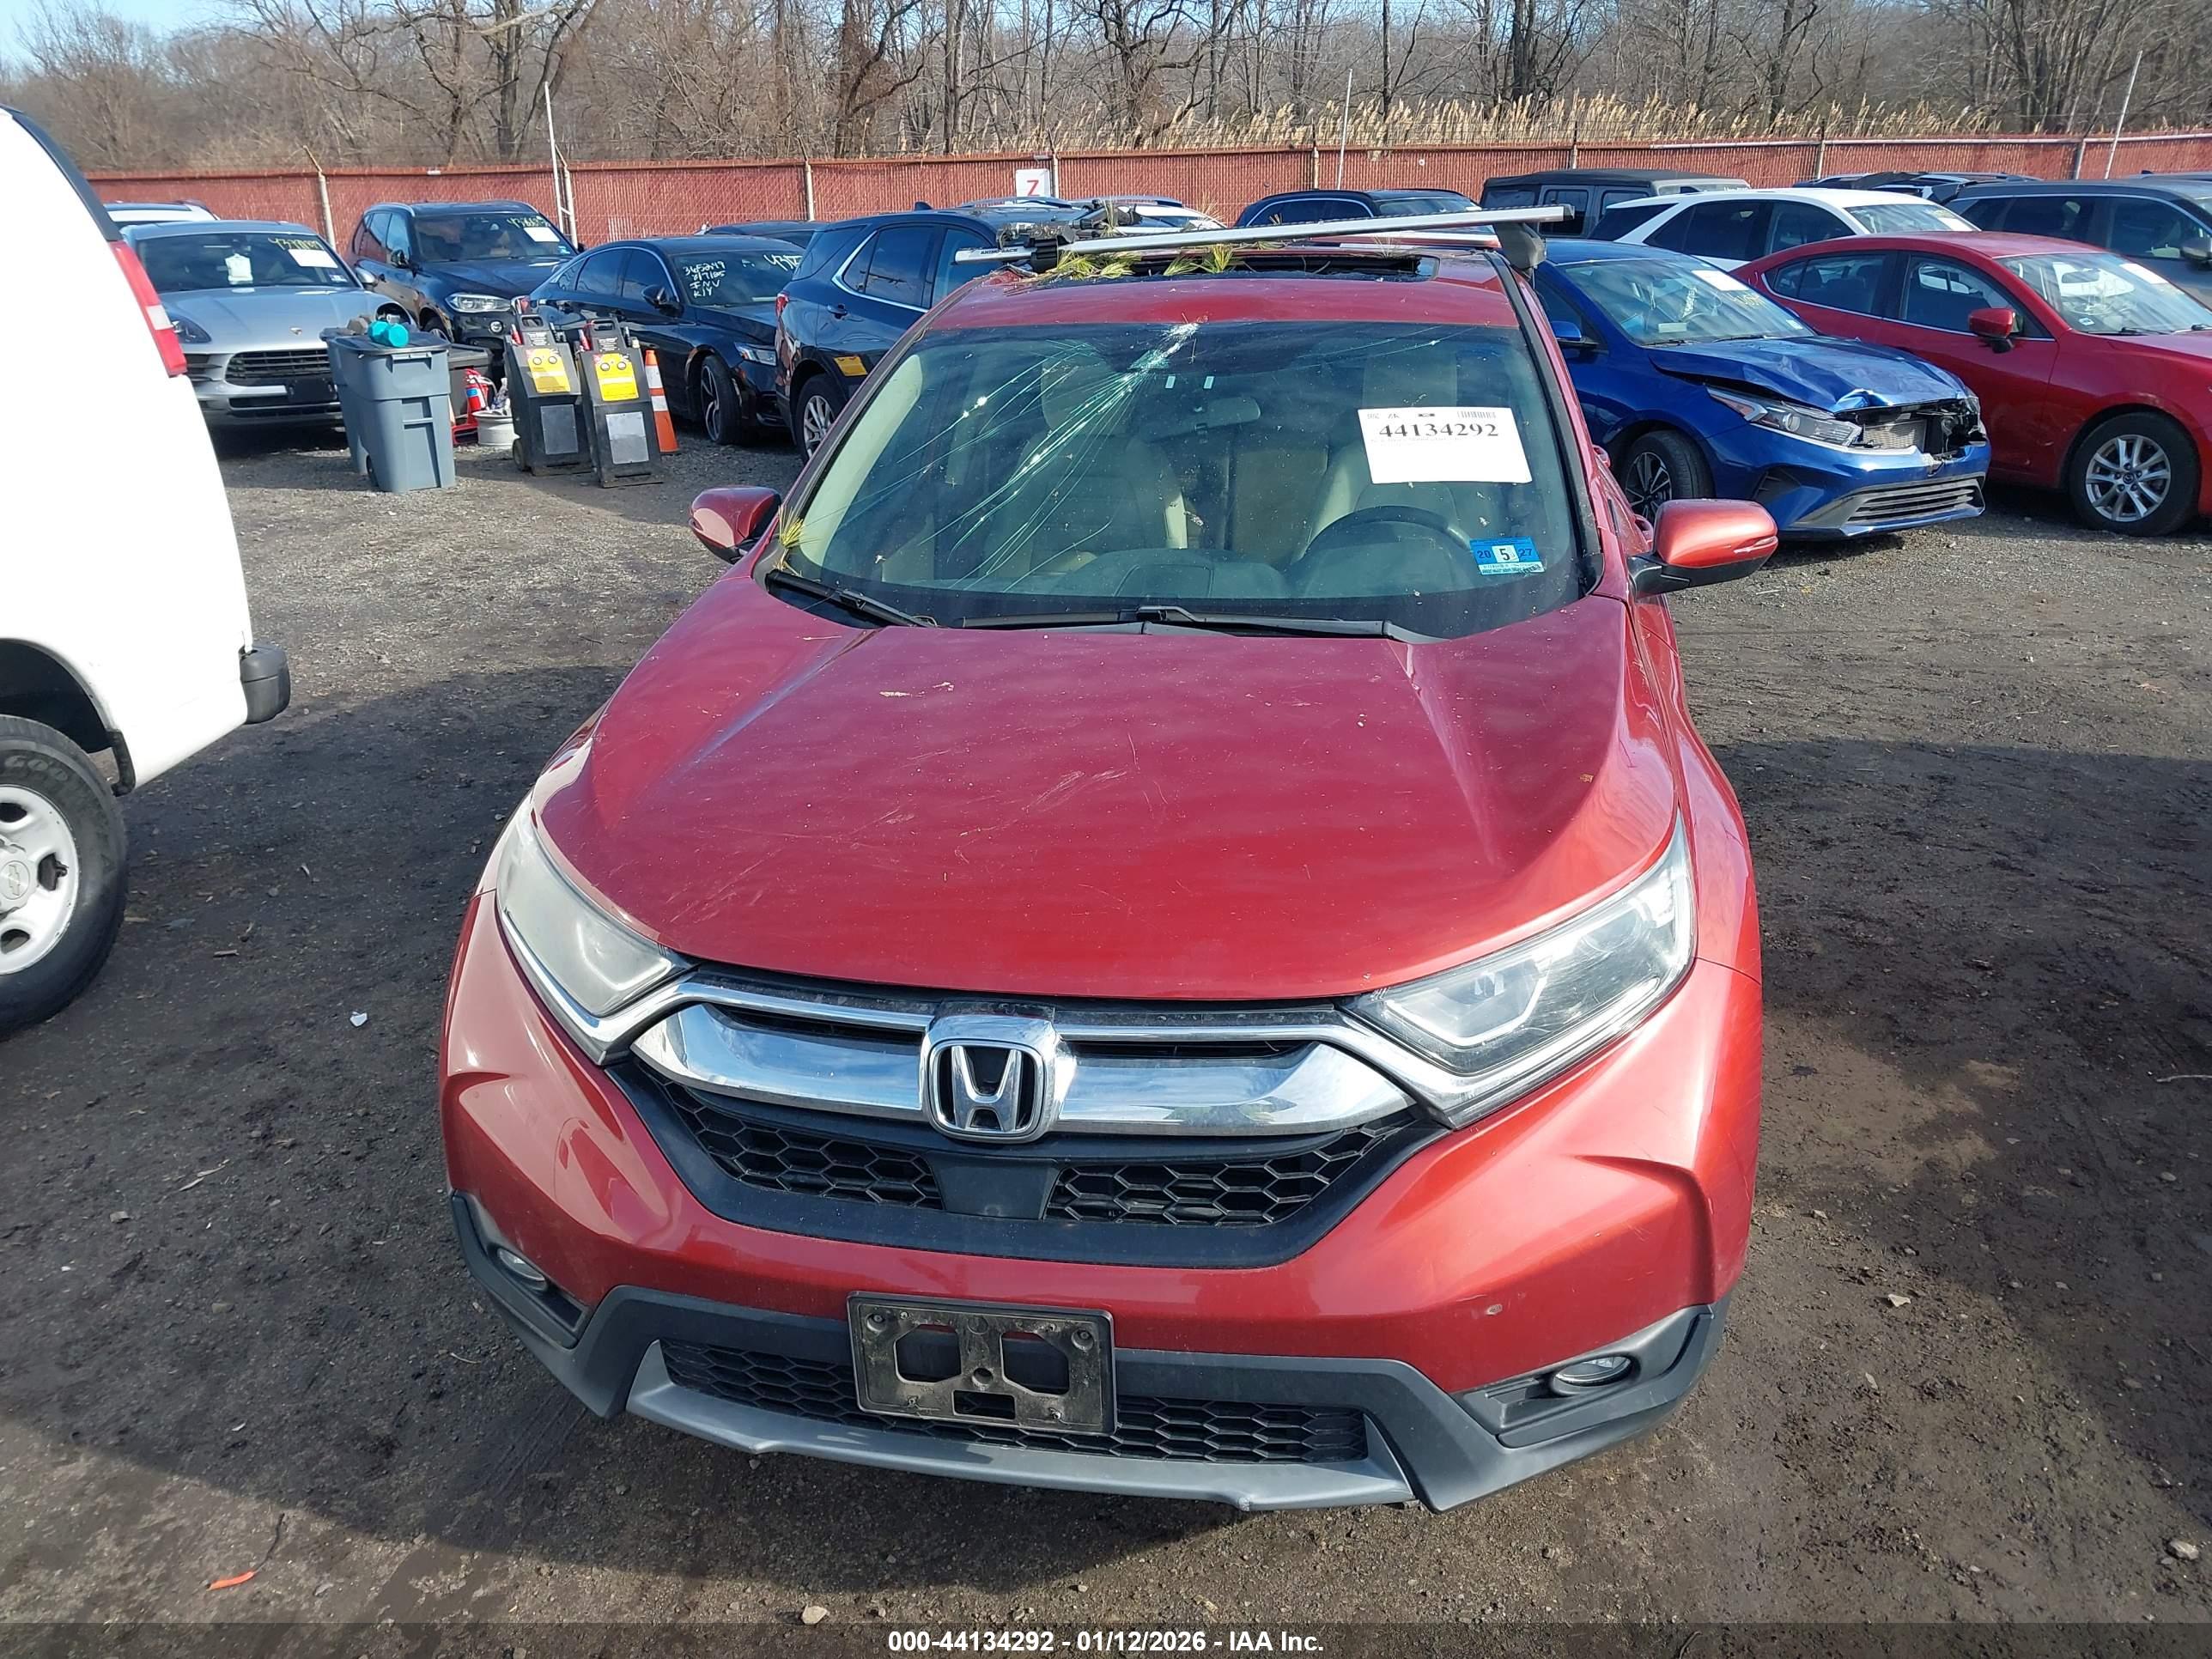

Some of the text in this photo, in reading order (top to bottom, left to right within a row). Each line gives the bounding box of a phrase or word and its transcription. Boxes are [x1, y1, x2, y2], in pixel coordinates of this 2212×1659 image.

[1379, 423, 1498, 437] 44134292
[1477, 548, 1532, 561] 20 5 27
